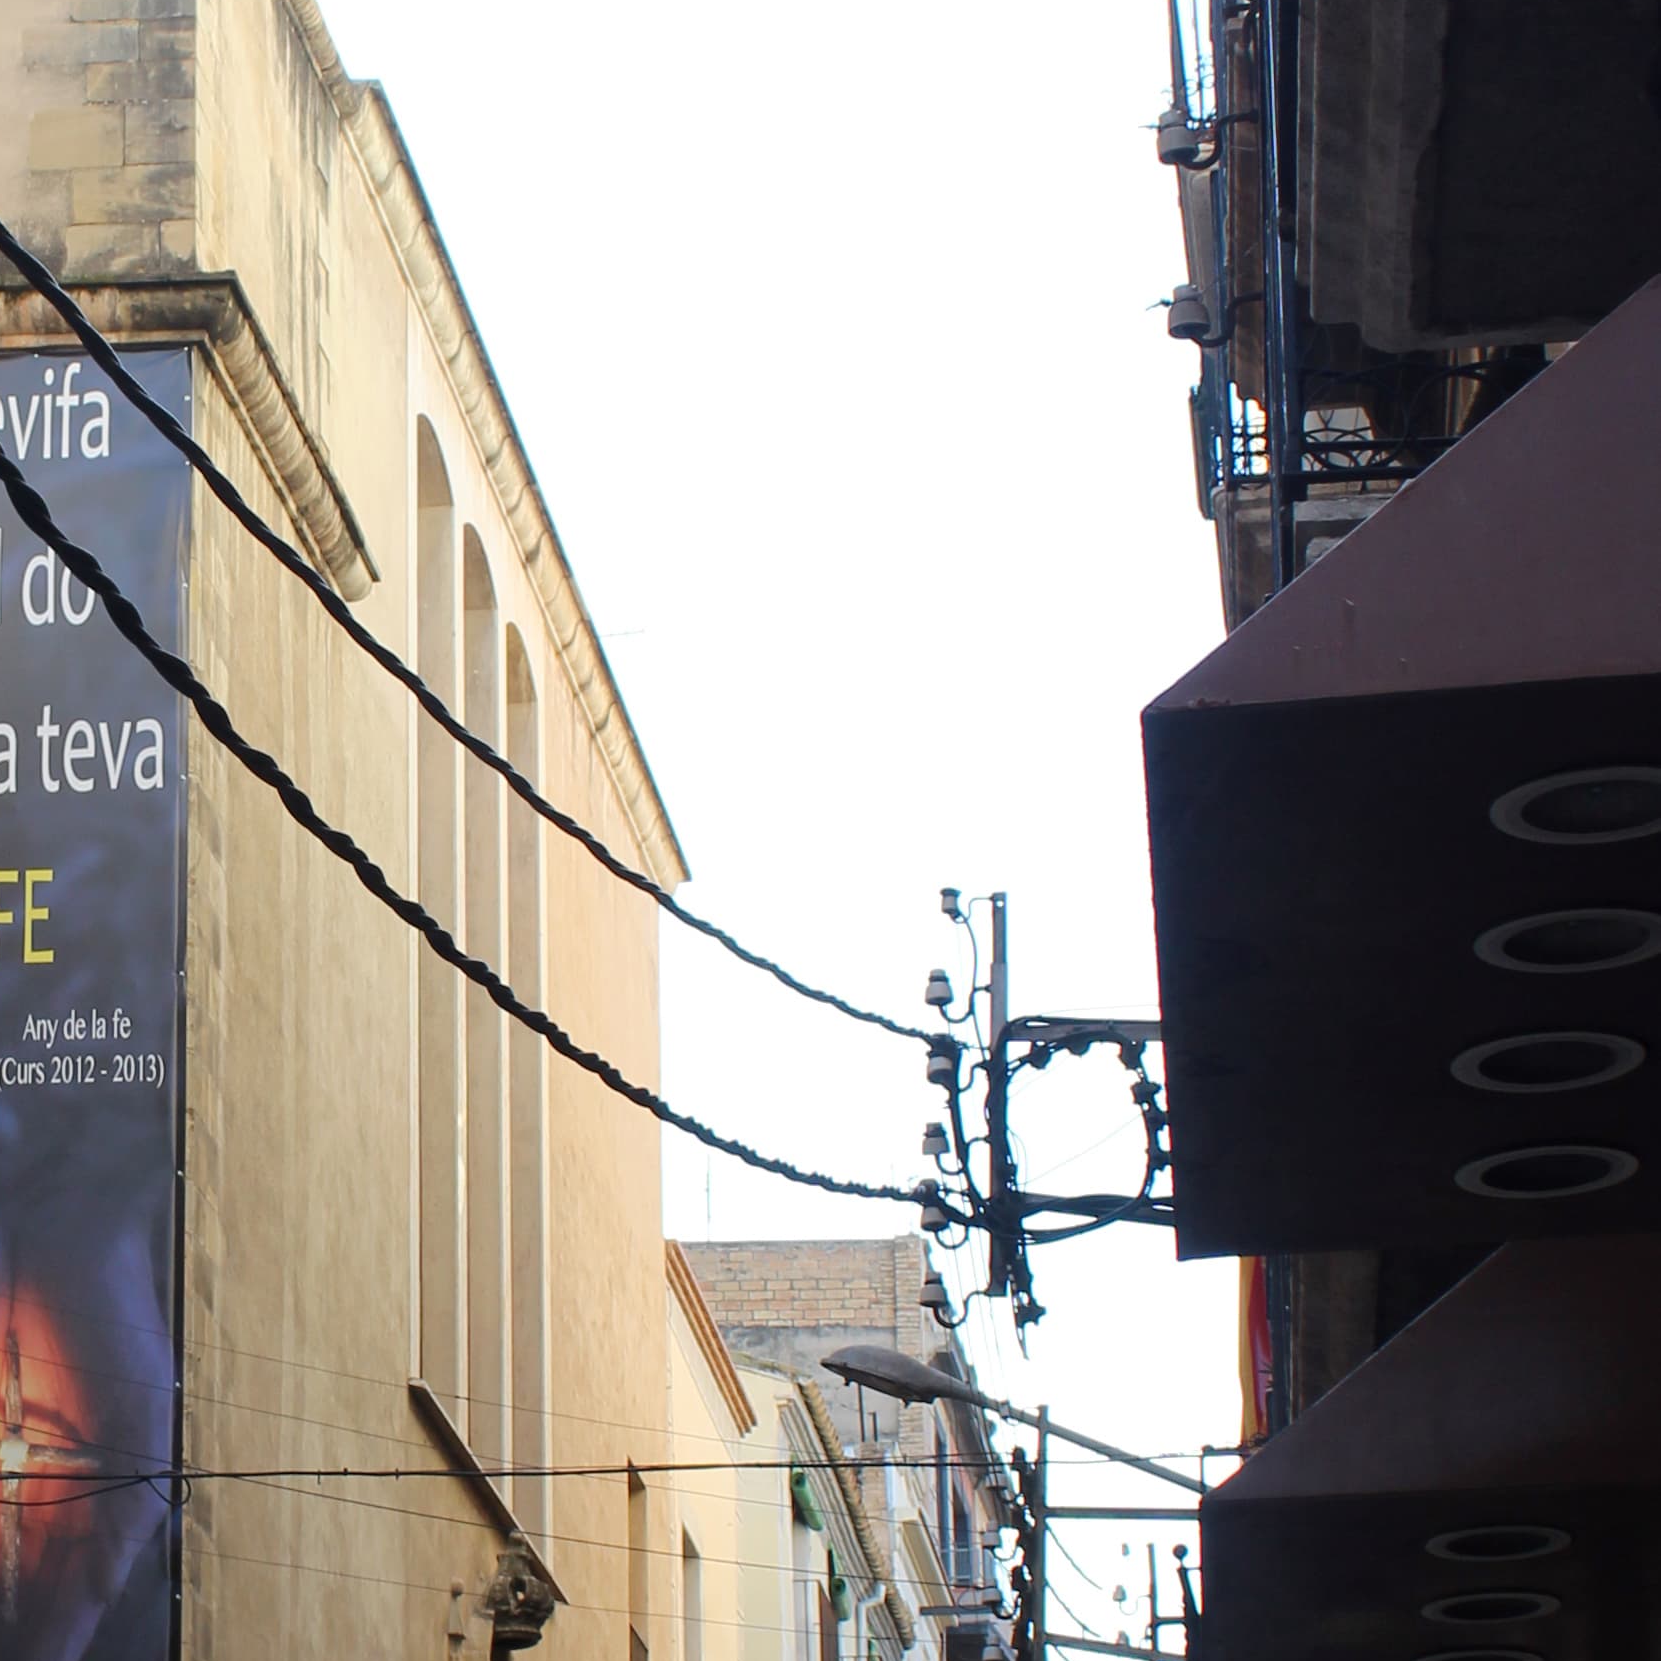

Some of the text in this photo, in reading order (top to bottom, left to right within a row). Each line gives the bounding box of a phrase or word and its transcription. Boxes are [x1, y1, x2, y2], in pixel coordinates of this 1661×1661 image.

[22, 538, 98, 626] do
[35, 704, 166, 794] teva
[22, 1007, 133, 1049] Any de la fe
[50, 1054, 96, 1085] 2012
[112, 1053, 166, 1089] 2013)
